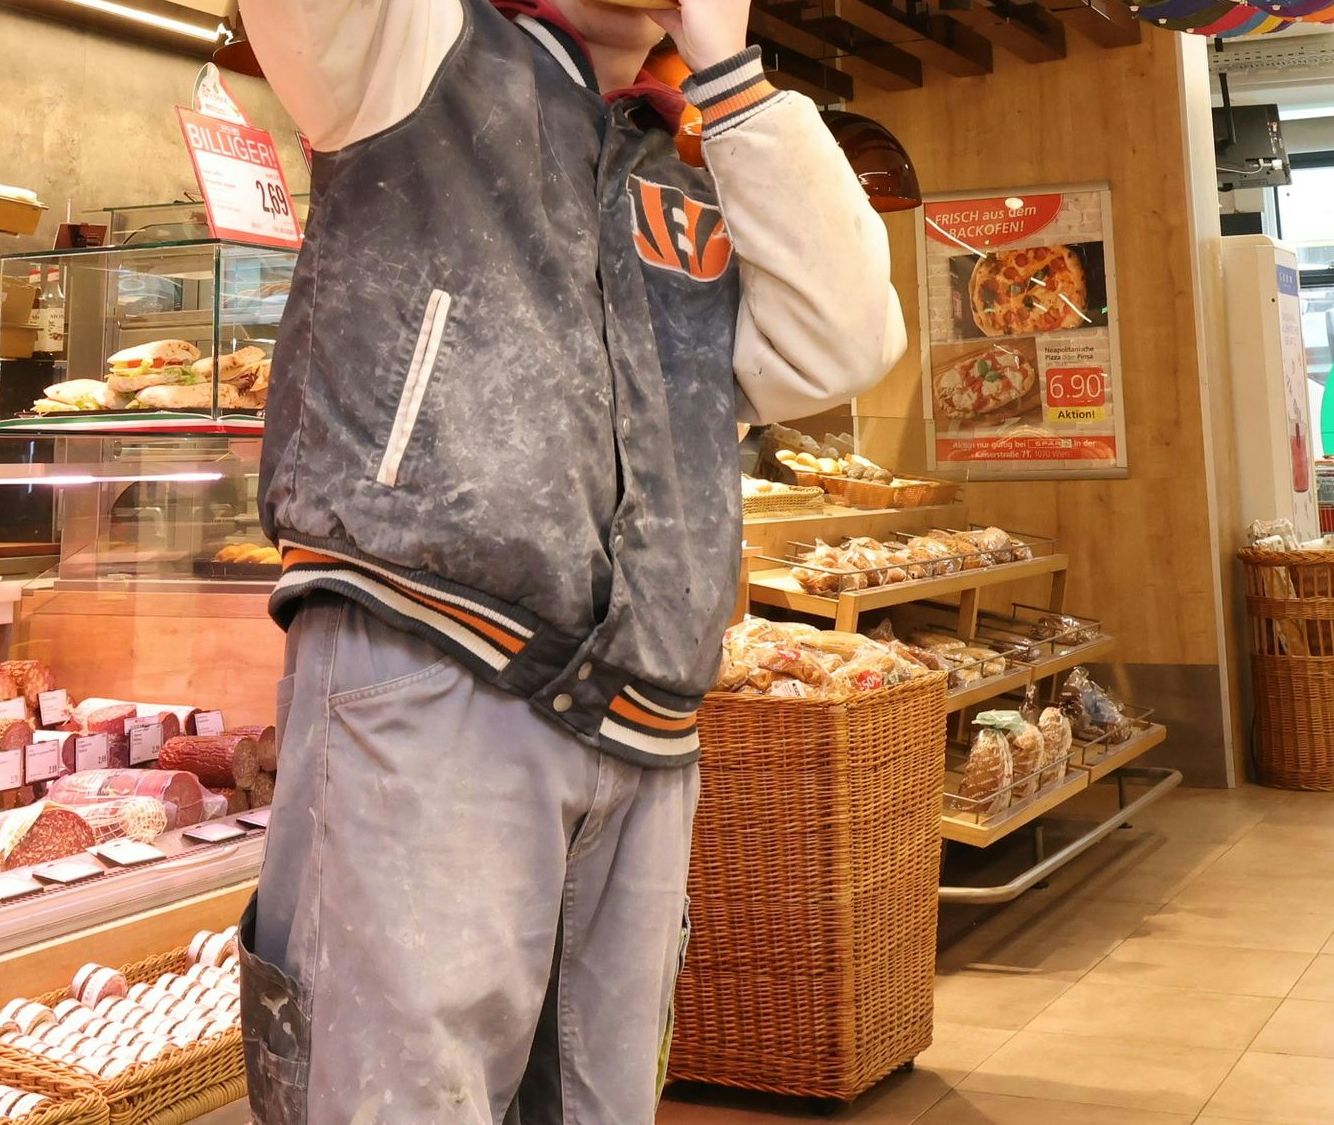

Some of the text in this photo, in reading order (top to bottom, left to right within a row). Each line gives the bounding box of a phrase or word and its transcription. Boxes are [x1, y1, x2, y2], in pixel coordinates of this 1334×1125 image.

[186, 123, 278, 169] BILLIGER!
[255, 180, 289, 220] 2,69
[934, 205, 1037, 225] FRISCH aus dem
[948, 221, 1024, 239] BACKOFEN!
[1049, 374, 1101, 399] 6.90
[1057, 409, 1095, 420] Aktion!
[1014, 440, 1026, 448] bei
[1082, 439, 1097, 447] der
